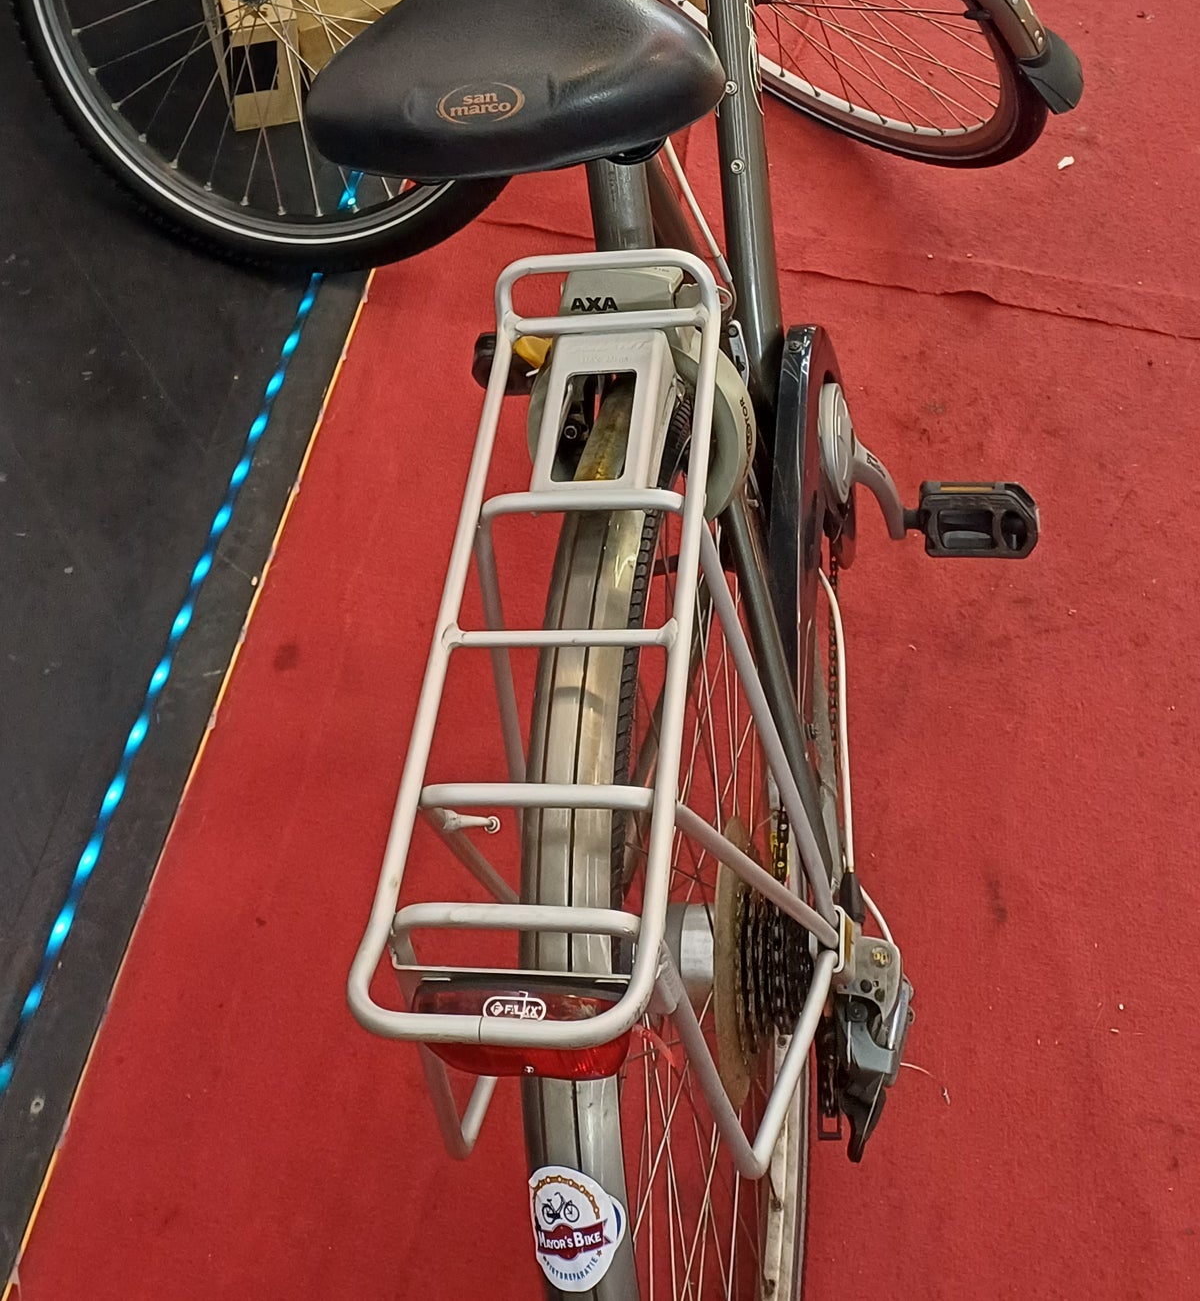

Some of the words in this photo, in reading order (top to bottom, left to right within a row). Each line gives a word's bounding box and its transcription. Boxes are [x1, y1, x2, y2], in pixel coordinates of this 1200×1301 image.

[463, 92, 498, 105] san
[450, 102, 511, 117] marco
[571, 297, 618, 312] AXA
[538, 1231, 574, 1249] MAYOR'S
[573, 1231, 602, 1248] BIKE
